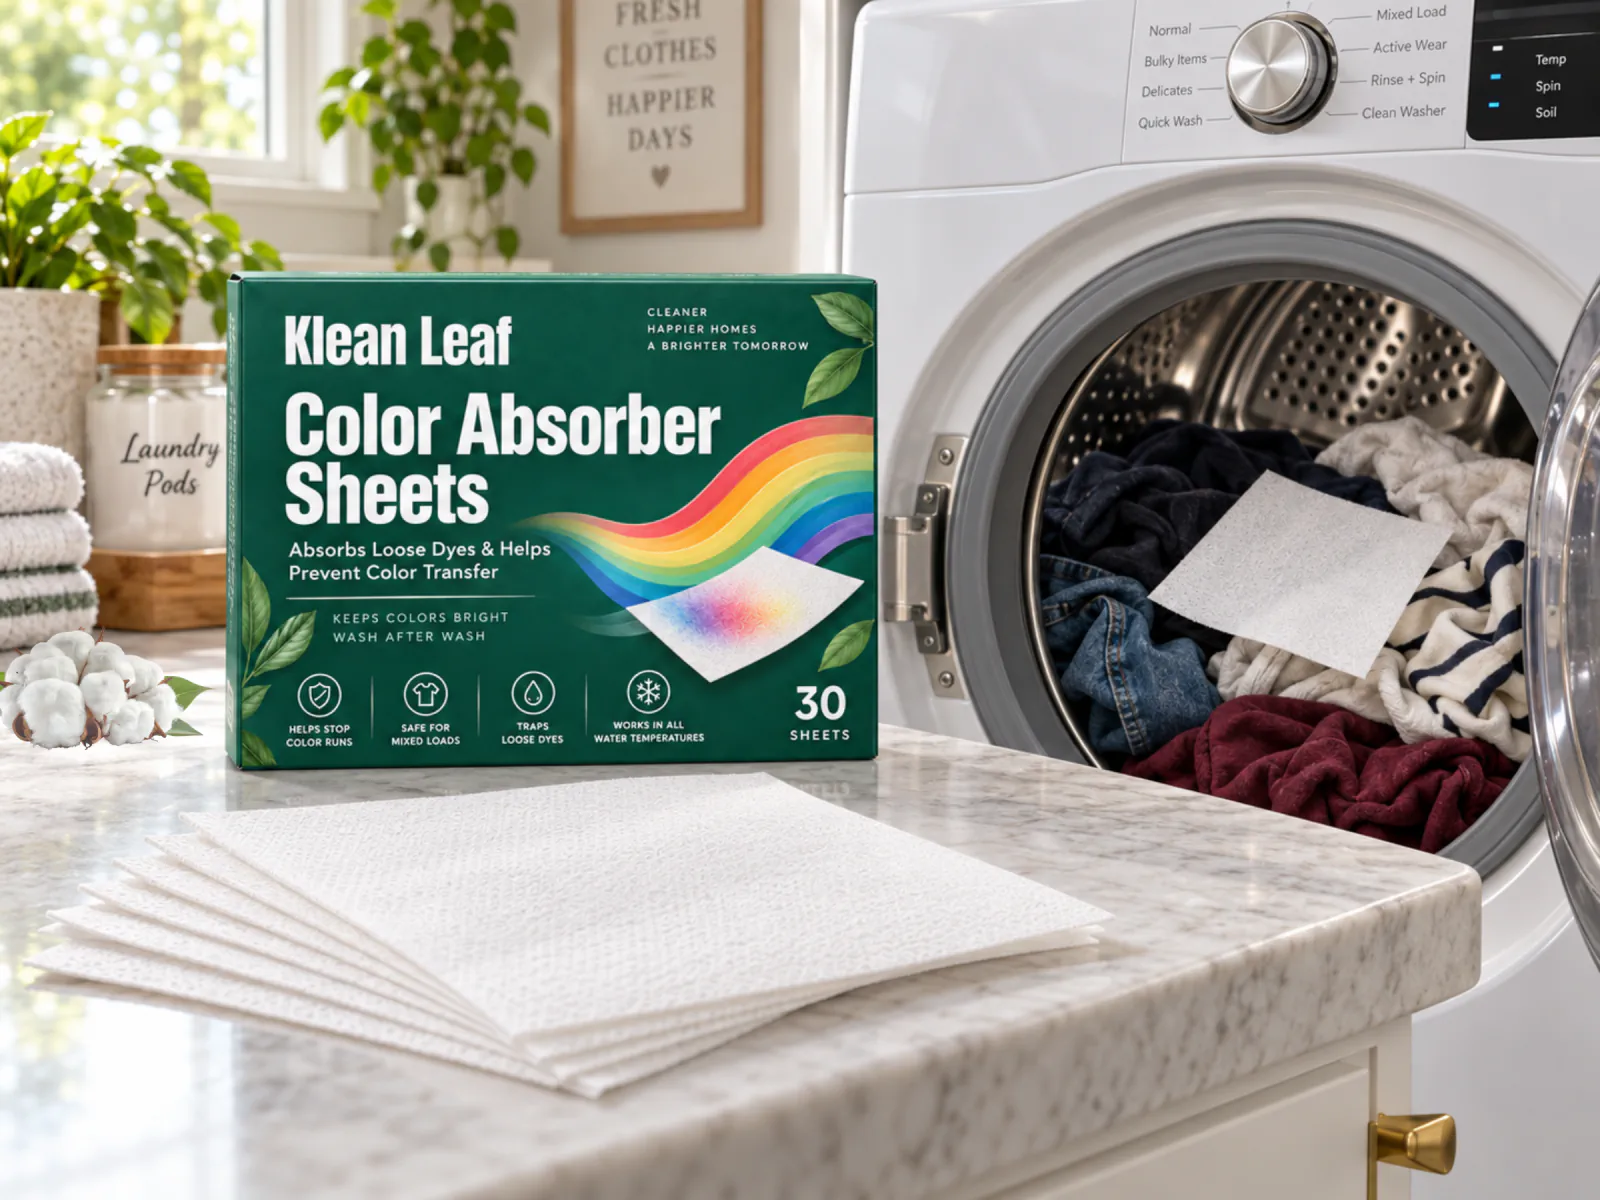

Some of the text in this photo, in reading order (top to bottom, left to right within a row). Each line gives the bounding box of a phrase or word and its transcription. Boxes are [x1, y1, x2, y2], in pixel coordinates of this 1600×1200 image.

[617, 0, 700, 26] FRESH
[1377, 5, 1446, 20] Mixed Load
[1150, 23, 1191, 36] Normal
[604, 37, 716, 68] CLOTHES
[1373, 40, 1447, 53] Active Wear
[1145, 54, 1207, 68] Bulky Items
[1536, 54, 1566, 66] Temp
[1371, 72, 1445, 86] Rinse + Spin
[1142, 86, 1192, 97] Delicates
[1536, 80, 1560, 94] Spin
[608, 86, 714, 116] HAPPIER
[1362, 105, 1446, 119] Clean Washer
[1536, 106, 1556, 118] Soil
[1138, 115, 1202, 130] Quick Wash
[629, 125, 692, 151] DAYS
[647, 308, 706, 316] CLEANER
[648, 325, 756, 334] HAPPIER HOMES
[285, 316, 512, 365] Klean Leaf
[648, 342, 808, 350] A BRIGHTER TOMORROW
[286, 392, 721, 456] Color Absorber
[120, 433, 220, 468] Laundry
[144, 469, 198, 497] Pods
[286, 461, 488, 525] Sheets
[289, 540, 550, 560] Absorbs Loose Dyes & Helps
[290, 563, 498, 580] Prevent Color Transfer
[333, 612, 508, 623] KEEPS COLORS BRIGHT
[333, 631, 484, 642] WASH AFTER WASH
[795, 685, 846, 720] 30
[289, 725, 350, 734] HELPS STOP
[402, 724, 450, 732] SAFE FOR
[517, 722, 549, 730] TRAPS
[613, 720, 685, 730] WORKS IN ALL
[392, 736, 460, 745] MIXED LOADS
[502, 735, 563, 744] LOOSE DYES
[593, 733, 705, 743] WATER TEMPERATURES
[791, 730, 849, 740] SHEETS
[286, 738, 353, 747] COLOR RUNS
